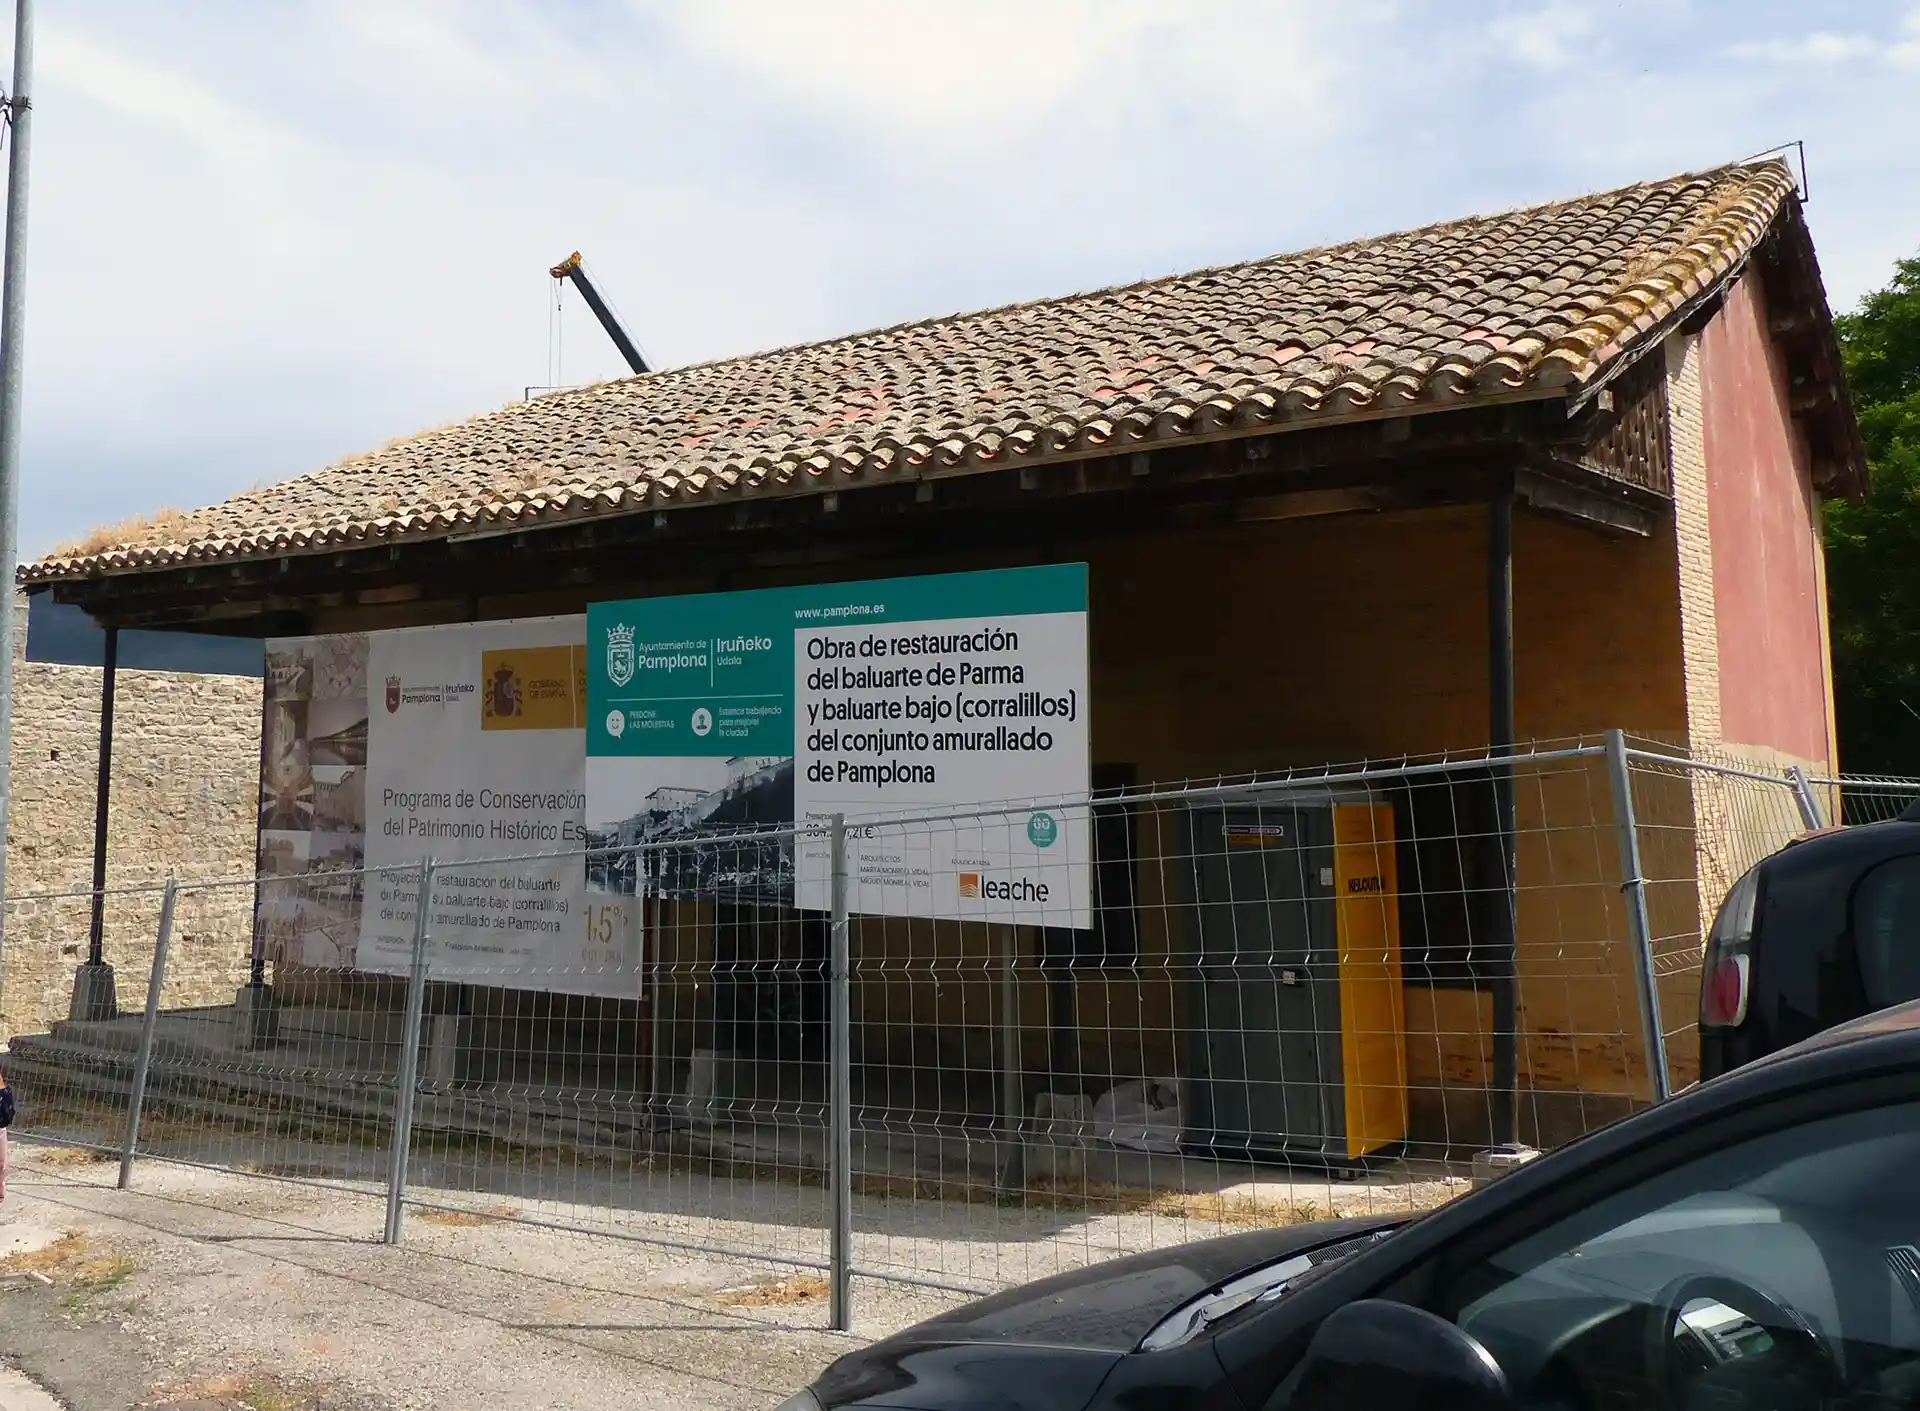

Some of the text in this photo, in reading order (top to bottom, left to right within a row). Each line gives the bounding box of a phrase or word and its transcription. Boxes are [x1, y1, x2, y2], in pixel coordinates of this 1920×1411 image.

[794, 603, 885, 619] www.pamplona.es
[639, 638, 707, 652] Ayuntamiento de
[717, 635, 772, 653] Iruñeko
[807, 627, 1018, 660] Obra de restauración
[638, 653, 707, 673] Pamplona
[717, 656, 742, 666] Udala
[807, 662, 1024, 691] del baluarte de Parma
[402, 693, 441, 706] Pamplona
[807, 689, 1076, 726] y baluarte bajo (corralillos)
[807, 726, 1053, 756] del conjunto amurallado
[807, 760, 935, 788] de Pamplona
[383, 788, 586, 812] Programa de Conservación
[383, 817, 587, 842] del Patrimonio Histórico Es
[437, 875, 496, 889] restauración
[500, 877, 515, 890] del
[517, 878, 561, 893] baluarte
[981, 875, 1050, 903] leache
[380, 907, 394, 920] del
[437, 913, 490, 928] amurallado
[494, 915, 505, 929] de
[508, 916, 560, 934] Pamplona
